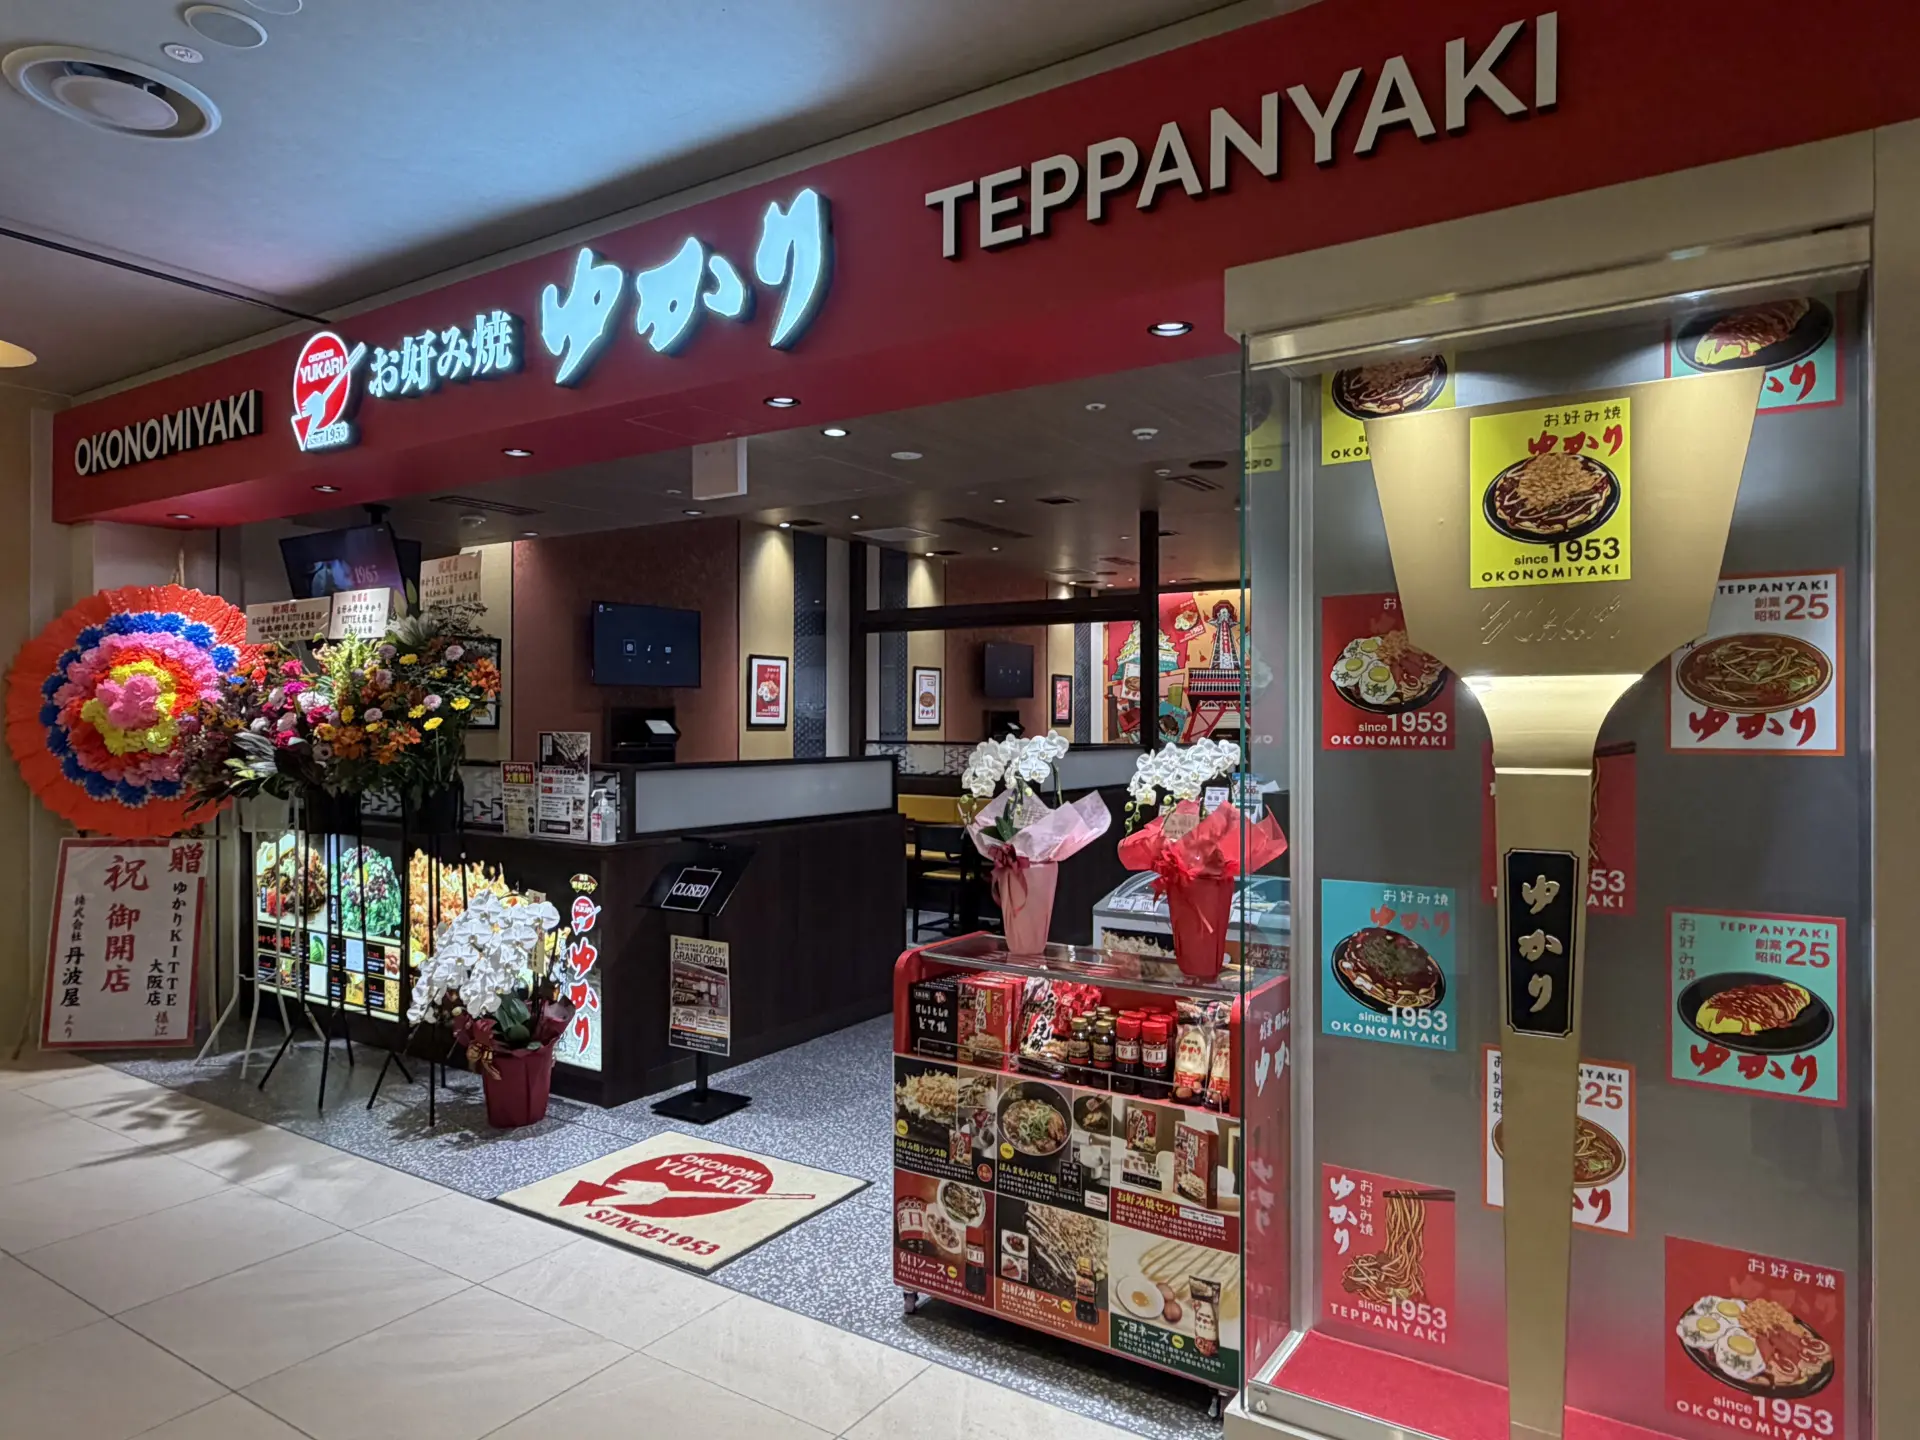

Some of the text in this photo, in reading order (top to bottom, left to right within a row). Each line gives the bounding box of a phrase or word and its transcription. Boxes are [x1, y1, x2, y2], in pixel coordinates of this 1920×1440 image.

[924, 10, 1558, 259] TEPPANYAKI
[541, 187, 822, 384] ゆかり
[369, 310, 513, 398] お好み焼
[300, 355, 345, 384] YUKARI
[1544, 406, 1621, 427] お好み焼
[74, 388, 257, 476] OKONOMIYAKI
[1528, 423, 1623, 457] ゆかり
[1514, 537, 1620, 565] since 1953
[1482, 564, 1620, 582] OKONOMIYAKI
[1718, 580, 1829, 595] TEPPANYAKI
[1784, 593, 1830, 621] 25
[1358, 712, 1448, 732] since 1953
[1689, 707, 1817, 747] ゆかり
[1331, 735, 1447, 746] OKONOMIYAKI
[168, 841, 204, 874] 贈
[672, 882, 709, 898] CLOSED
[1383, 890, 1449, 906] お好み焼
[1370, 904, 1451, 939] ゆかり
[1719, 921, 1830, 939] TEPPANYAKI
[1517, 874, 1564, 1013] ゆかり
[1678, 918, 1696, 981] お好み焼
[1785, 940, 1831, 968] 25
[673, 950, 702, 963] GRAND
[703, 954, 727, 967] OPEN
[569, 936, 600, 1056] ゆかり
[1331, 1021, 1447, 1045] OKONOMIYAKI
[1358, 1006, 1448, 1031] since 1953
[1690, 1041, 1819, 1093] ゆかり
[1584, 1081, 1624, 1110] 25
[654, 1158, 760, 1195] YUKARI
[681, 1153, 768, 1183] OKONOMI
[1116, 1191, 1179, 1217] お好み焼セット
[1329, 1174, 1358, 1256] ゆかり
[1360, 1179, 1374, 1237] お好み焼
[899, 1251, 947, 1276] 辛口ソース
[1748, 1258, 1836, 1290] お好み焼
[1001, 1281, 1061, 1309] お好み焼ソース
[1330, 1303, 1446, 1344] TEPPANYAKI
[1357, 1296, 1448, 1330] since 1953
[1117, 1319, 1170, 1344] マヨネーズ
[1713, 1395, 1834, 1436] since 1953
